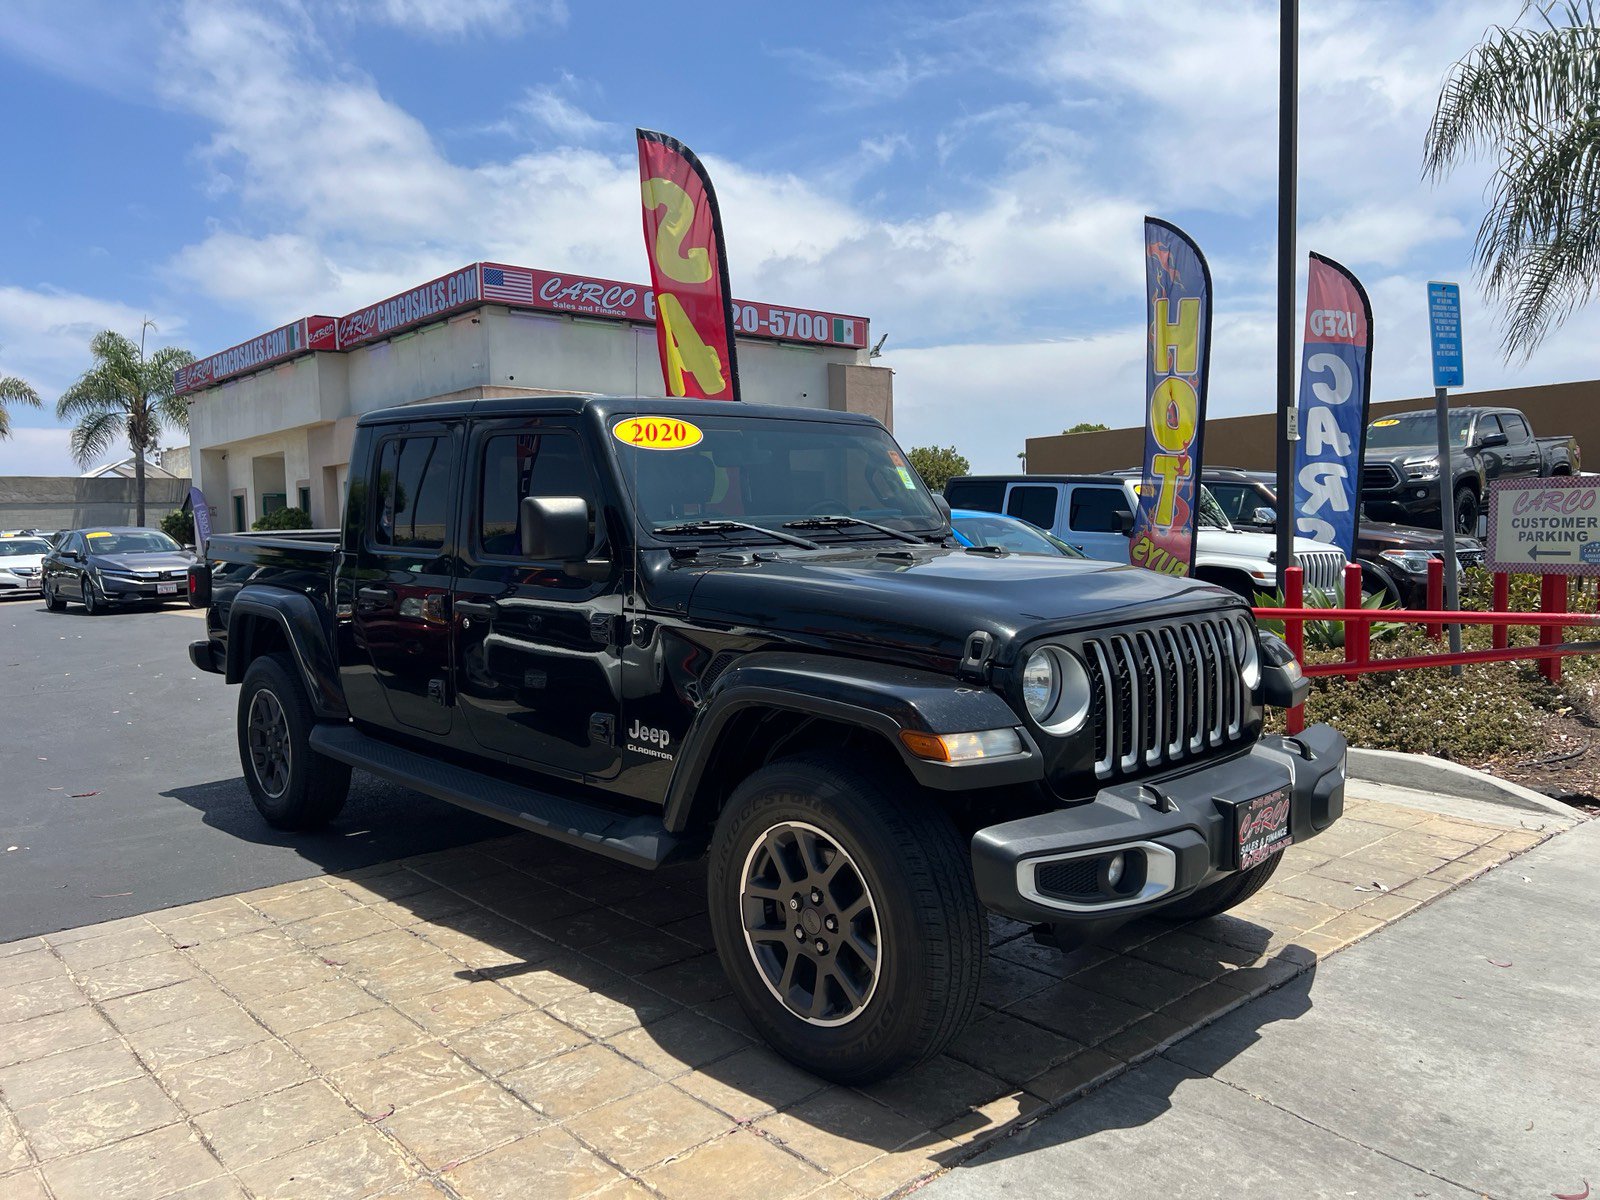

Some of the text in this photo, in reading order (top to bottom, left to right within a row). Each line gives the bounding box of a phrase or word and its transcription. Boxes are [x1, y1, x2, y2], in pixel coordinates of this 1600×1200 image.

[340, 267, 477, 341] CARCO CARCOSALES.COM
[540, 277, 637, 309] CARCO
[553, 301, 576, 310] Sales
[595, 306, 626, 316] Finance
[308, 323, 335, 342] CARCO
[186, 328, 288, 385] CARCO CARCOSALES.COM
[631, 423, 687, 442] 2020
[1512, 489, 1597, 515] CARCO
[1511, 516, 1598, 529] CUSTOMER
[1518, 531, 1589, 542] PARKING
[628, 719, 670, 749] Jeep
[627, 743, 673, 761] GLADIATOR
[1239, 798, 1290, 845] CARCO
[1241, 839, 1260, 855] SALES
[1265, 826, 1288, 845] FINANCE
